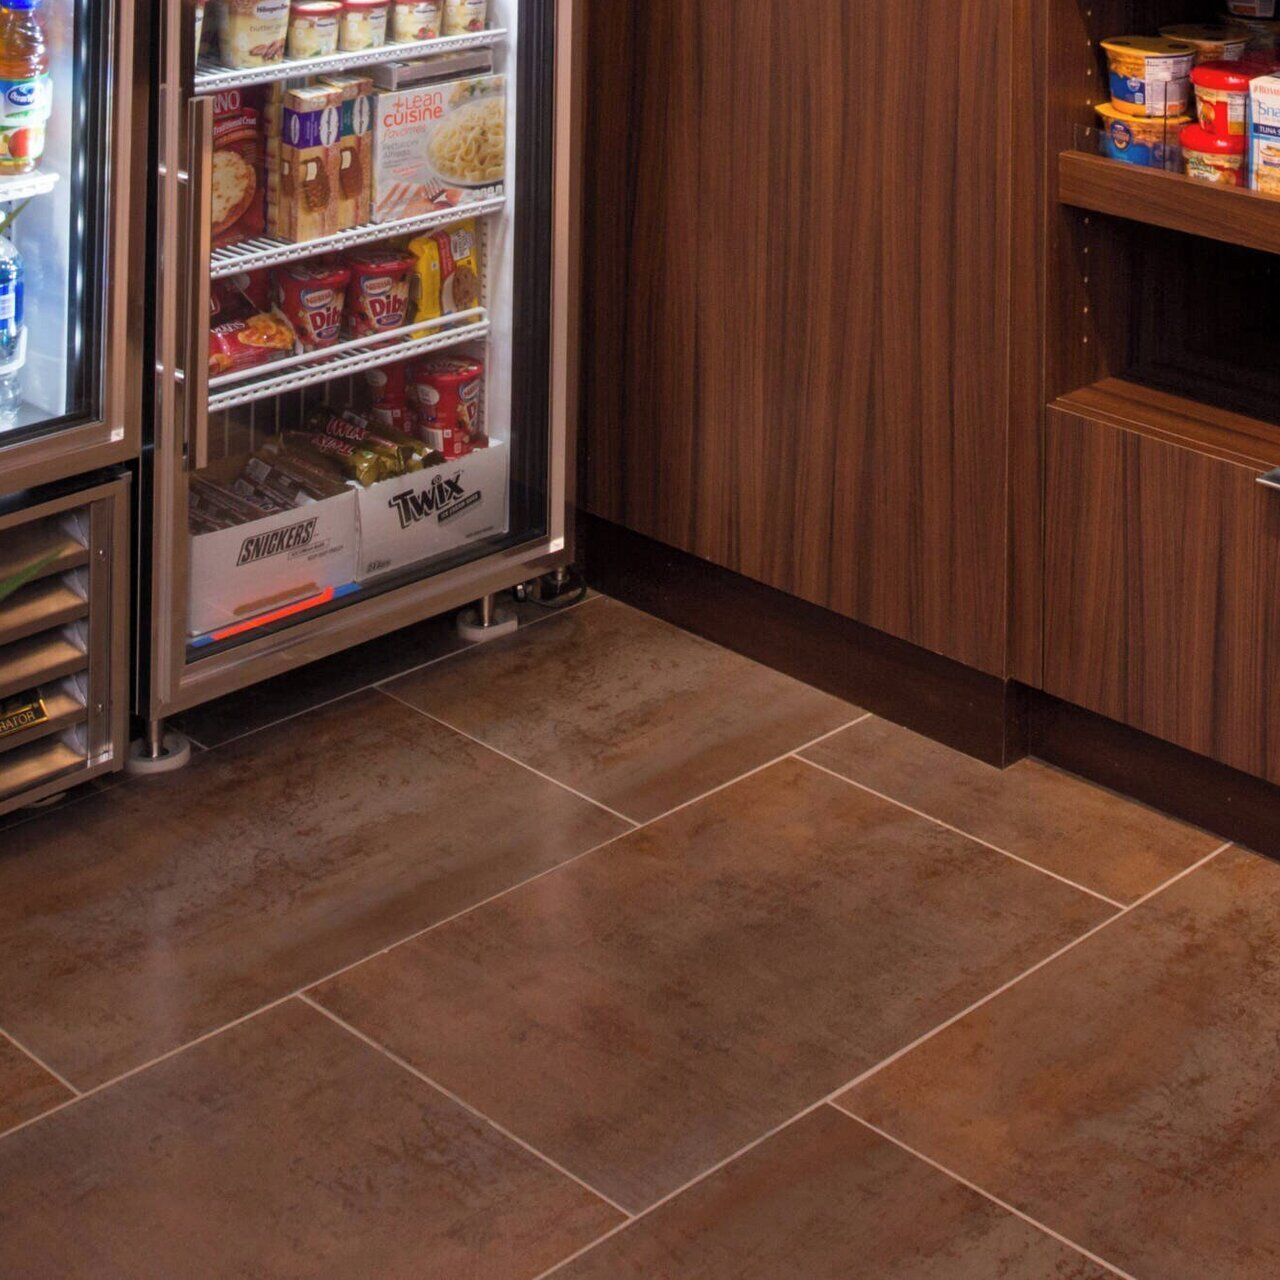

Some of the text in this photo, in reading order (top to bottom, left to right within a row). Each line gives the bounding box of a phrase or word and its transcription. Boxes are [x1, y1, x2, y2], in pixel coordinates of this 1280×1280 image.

[406, 91, 443, 111] Lean
[382, 105, 443, 129] cuisine
[1259, 126, 1277, 136] TUNA
[389, 472, 466, 529] Twix
[240, 517, 318, 566] SNICKERS
